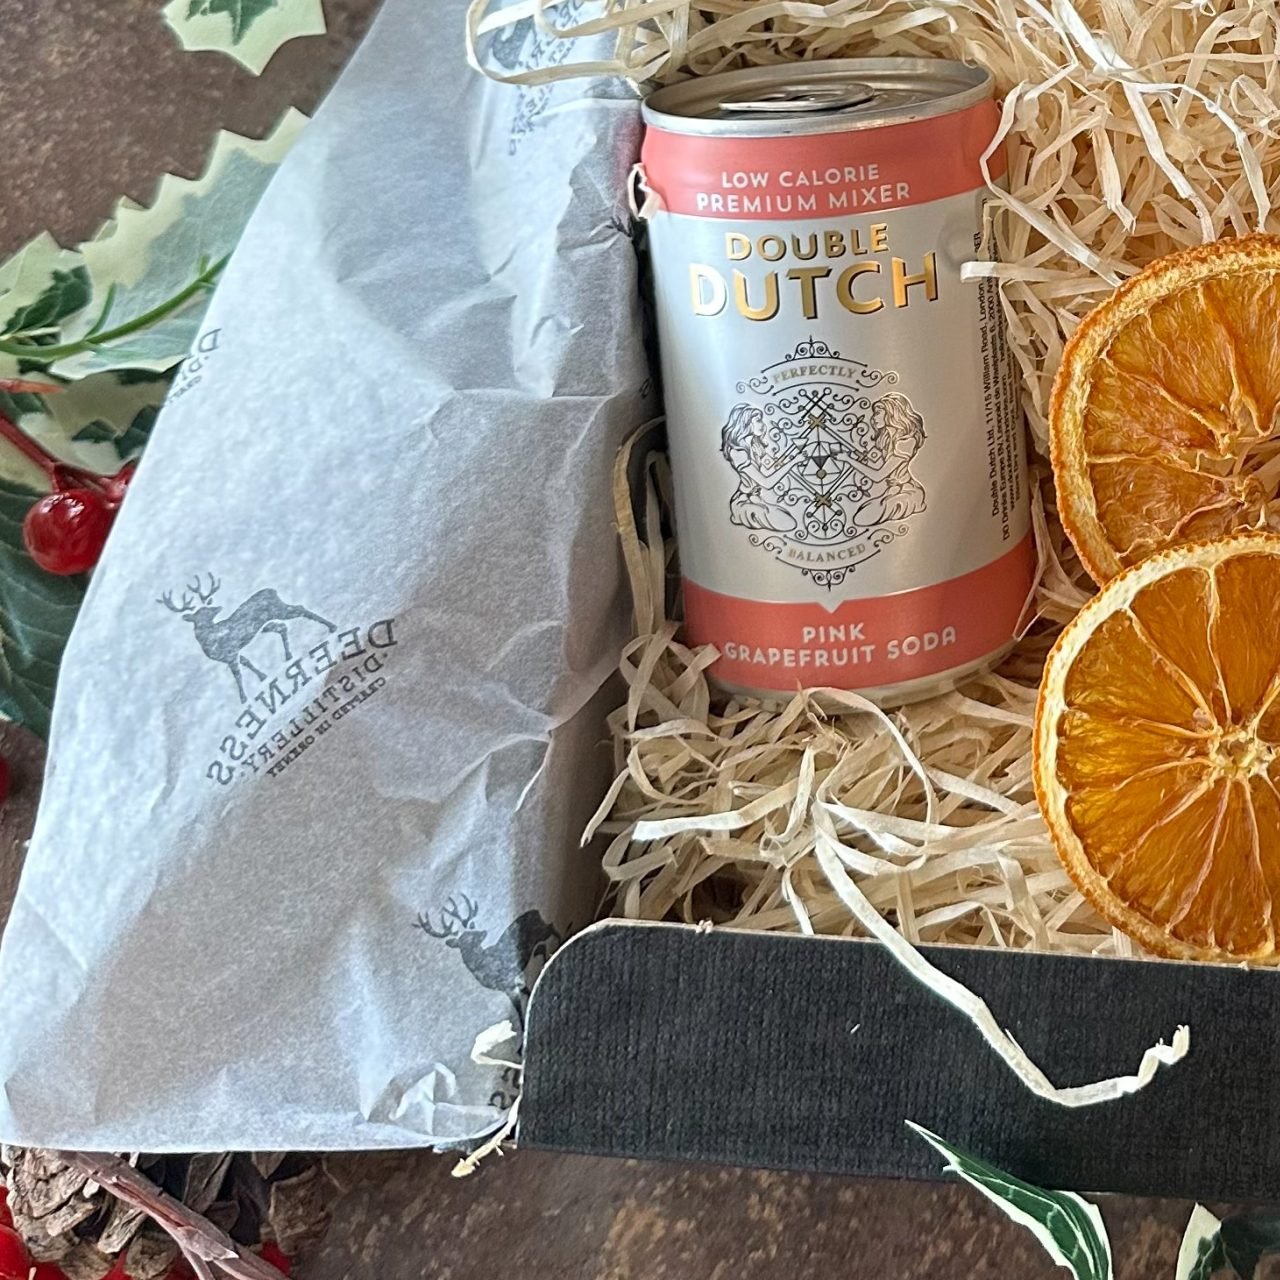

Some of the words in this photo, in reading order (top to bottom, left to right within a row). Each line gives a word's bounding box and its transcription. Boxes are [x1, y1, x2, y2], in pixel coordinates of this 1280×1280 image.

[721, 171, 769, 189] LOW
[778, 164, 880, 188] CALORIE
[696, 192, 817, 213] PREMIUM
[829, 182, 911, 209] MIXER
[725, 222, 889, 261] DOUBLE
[689, 249, 939, 321] DUTCH
[976, 281, 987, 321] London
[772, 364, 857, 384] PERFECTLY
[980, 354, 992, 393] William
[986, 446, 997, 479] Dutch
[988, 479, 1000, 516] Double
[786, 543, 866, 562] BALANCED
[723, 641, 877, 667] GRAPEFRUIT
[887, 626, 957, 660] SODA
[802, 622, 865, 643] PINK
